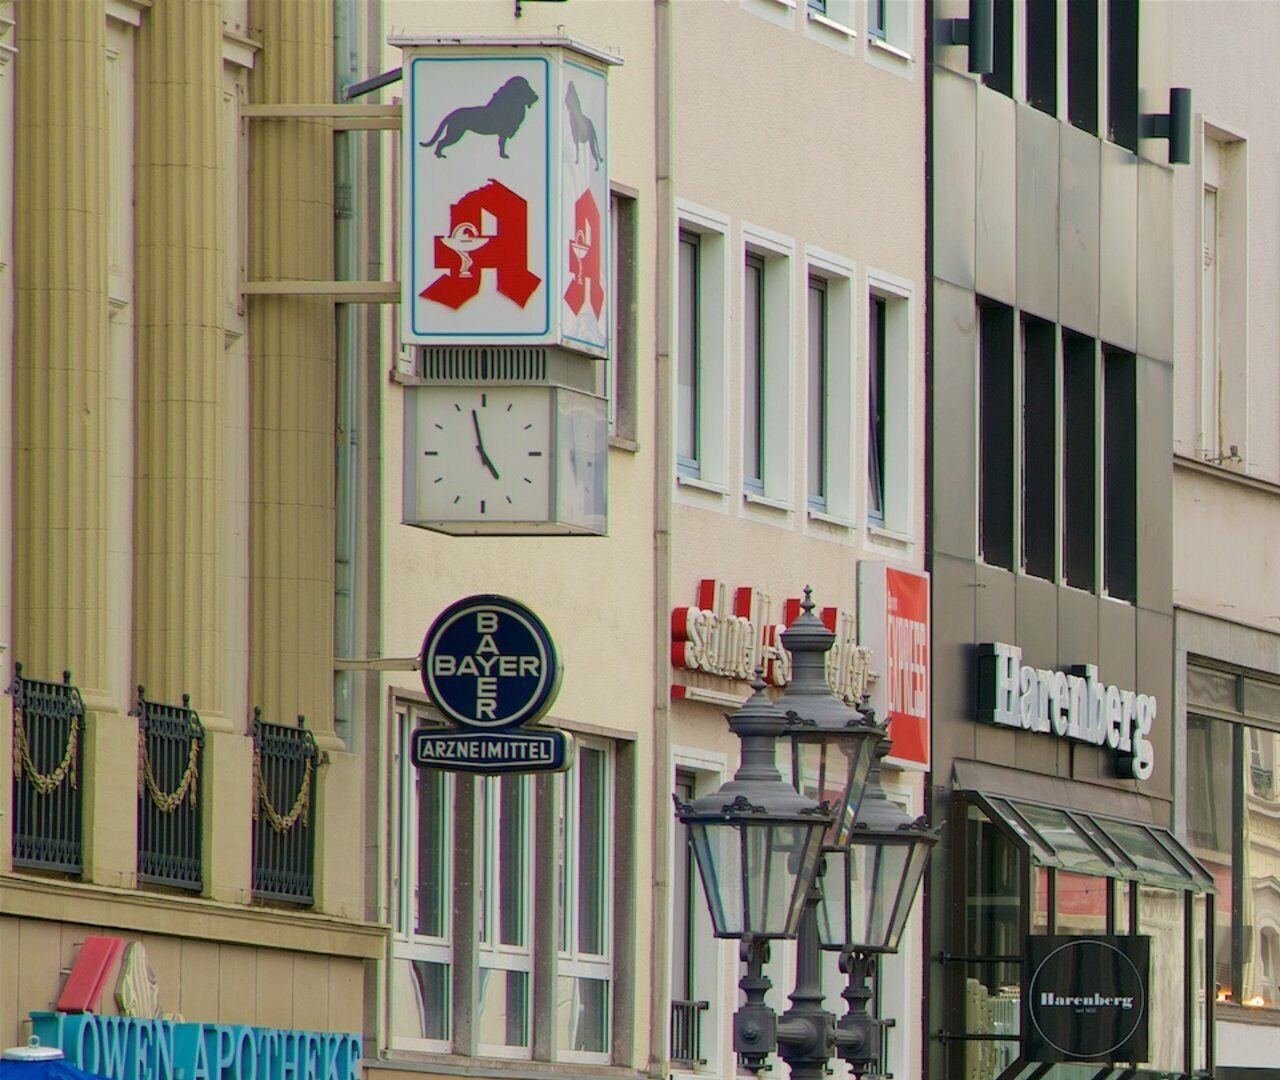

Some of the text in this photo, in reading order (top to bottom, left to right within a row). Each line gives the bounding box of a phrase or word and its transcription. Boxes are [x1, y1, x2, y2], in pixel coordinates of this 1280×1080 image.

[433, 655, 541, 678] BAYER
[476, 612, 500, 720] BAYER
[993, 641, 1157, 781] Harenberg
[421, 740, 552, 762] ARZNEIMITTEL
[1041, 992, 1134, 1010] Harenberg
